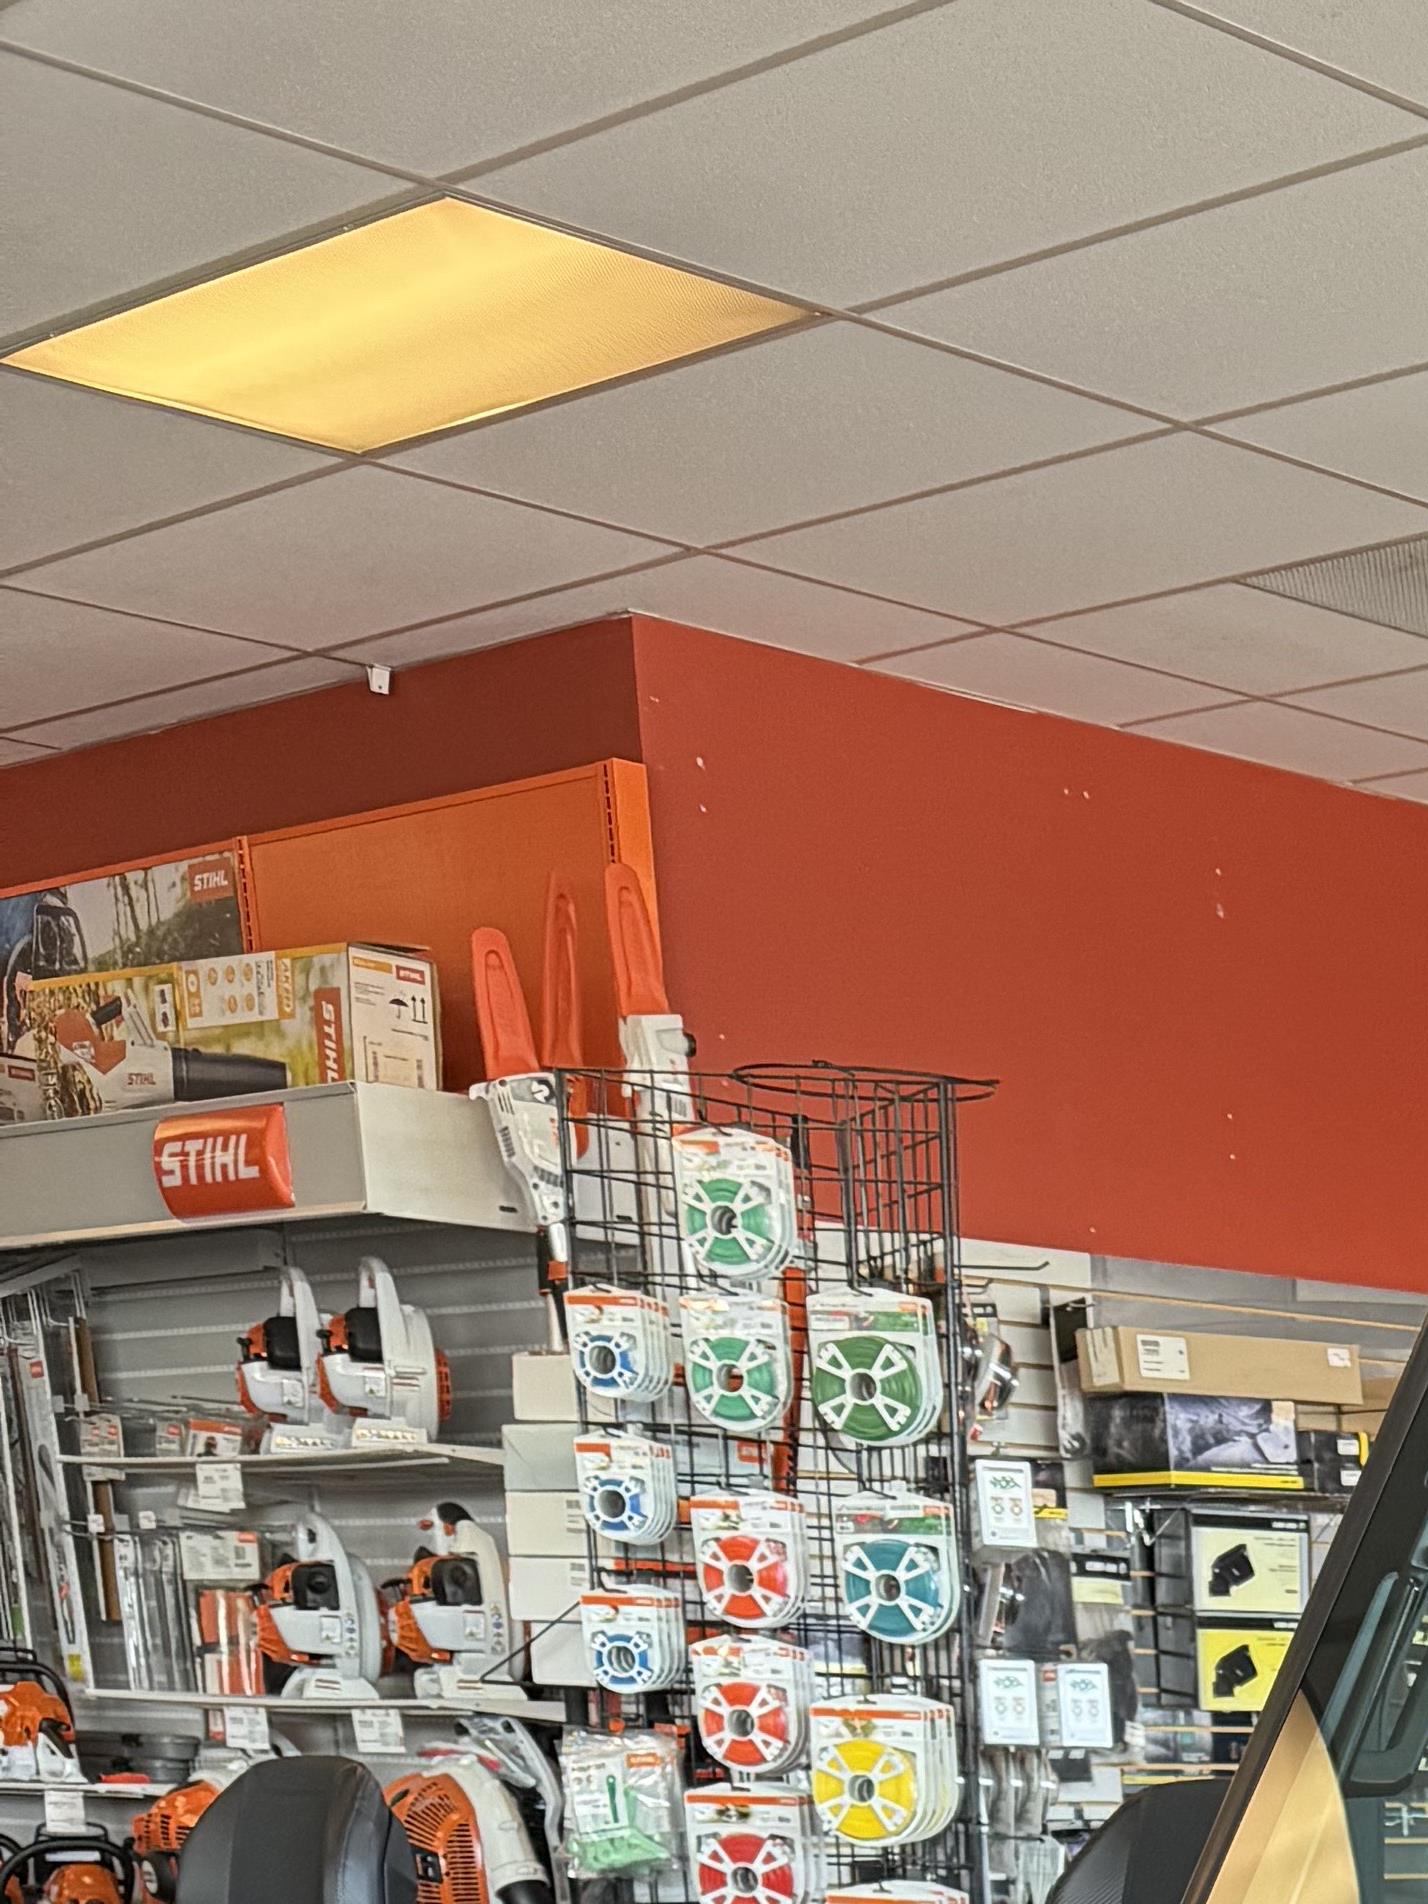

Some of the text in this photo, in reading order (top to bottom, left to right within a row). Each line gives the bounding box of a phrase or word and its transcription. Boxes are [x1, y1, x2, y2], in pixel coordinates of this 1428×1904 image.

[193, 869, 229, 891] STIHL
[321, 1000, 340, 1083] STIHL
[127, 1073, 157, 1085] STIHL
[160, 1133, 260, 1188] STIHL
